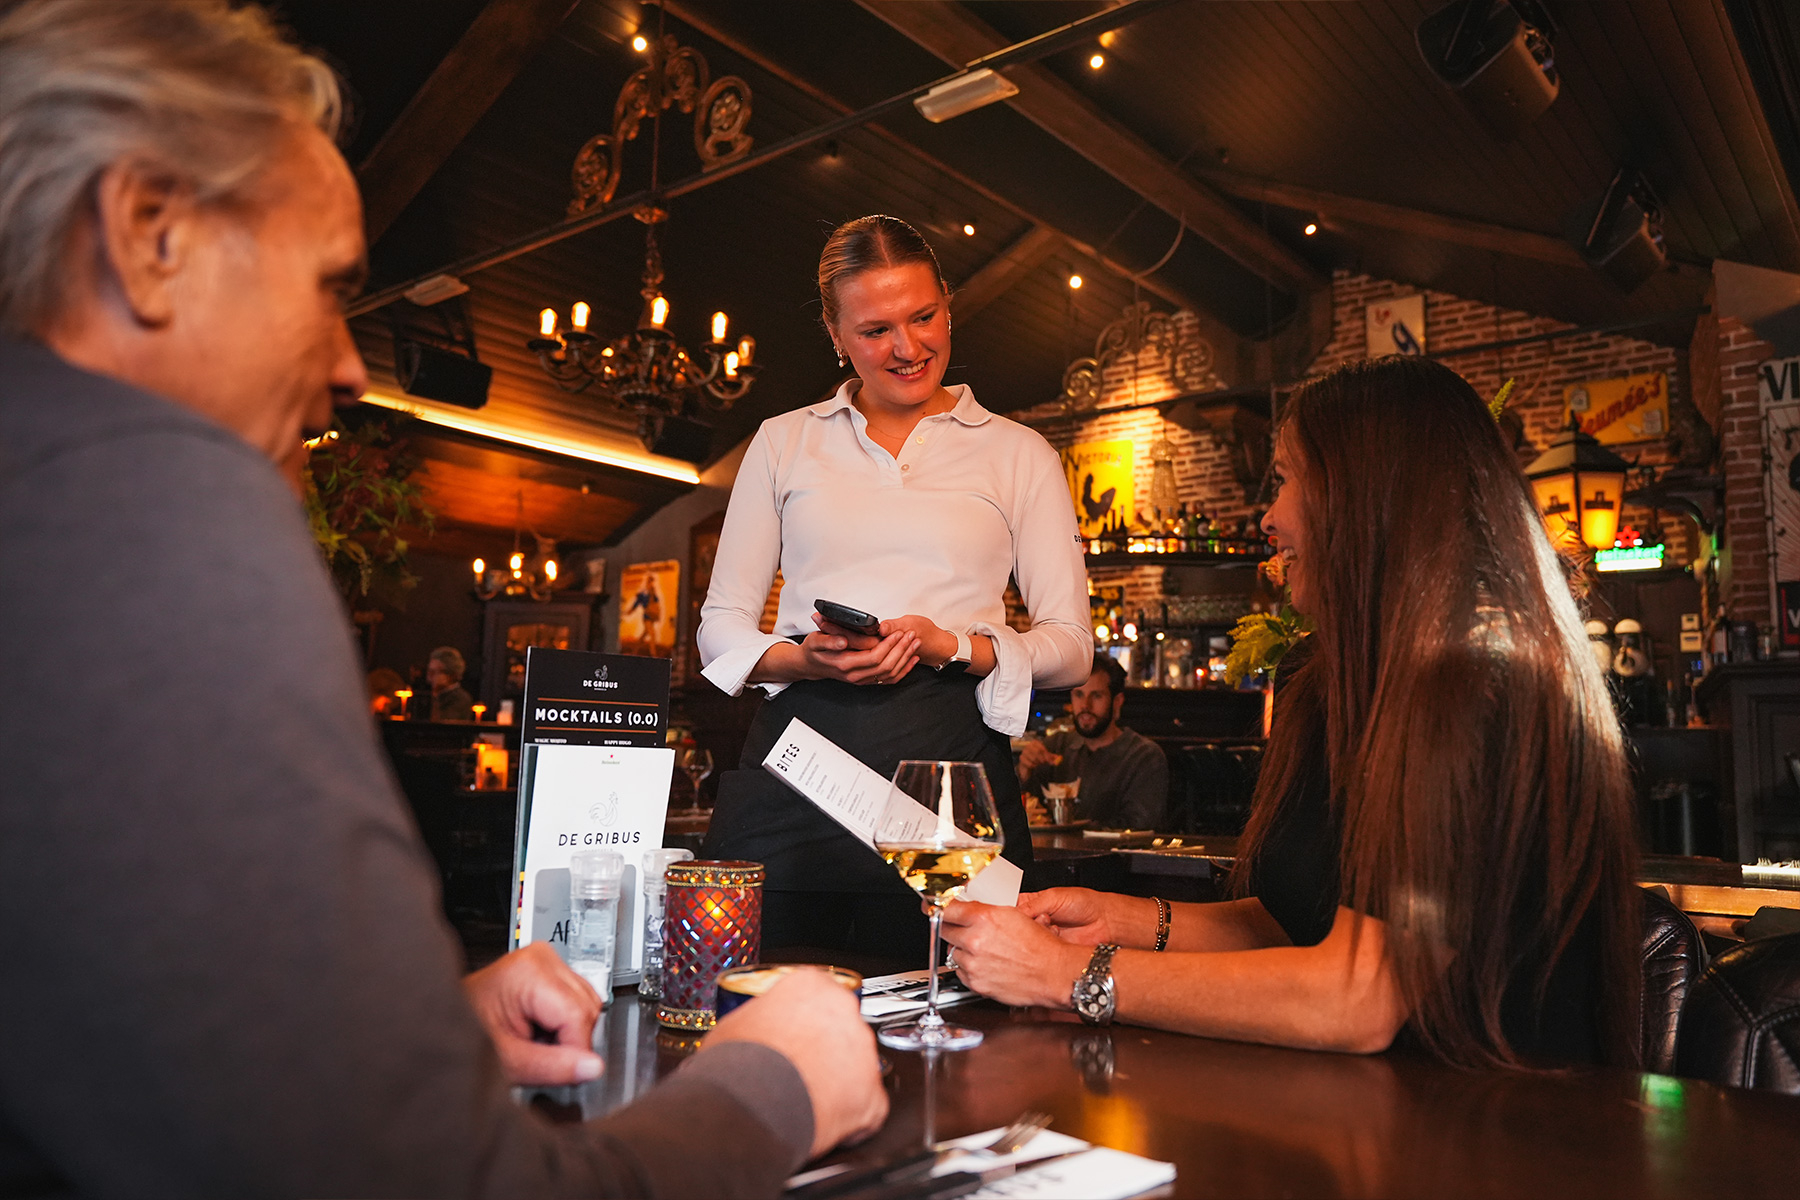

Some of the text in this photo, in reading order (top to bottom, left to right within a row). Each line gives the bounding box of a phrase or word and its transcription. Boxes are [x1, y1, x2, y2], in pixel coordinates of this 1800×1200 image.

[582, 679, 619, 689] DE GRIBUS
[535, 708, 659, 727] MOCKTAILS (0.0)
[776, 742, 801, 773] BITES
[558, 831, 641, 847] DE GRIBUS
